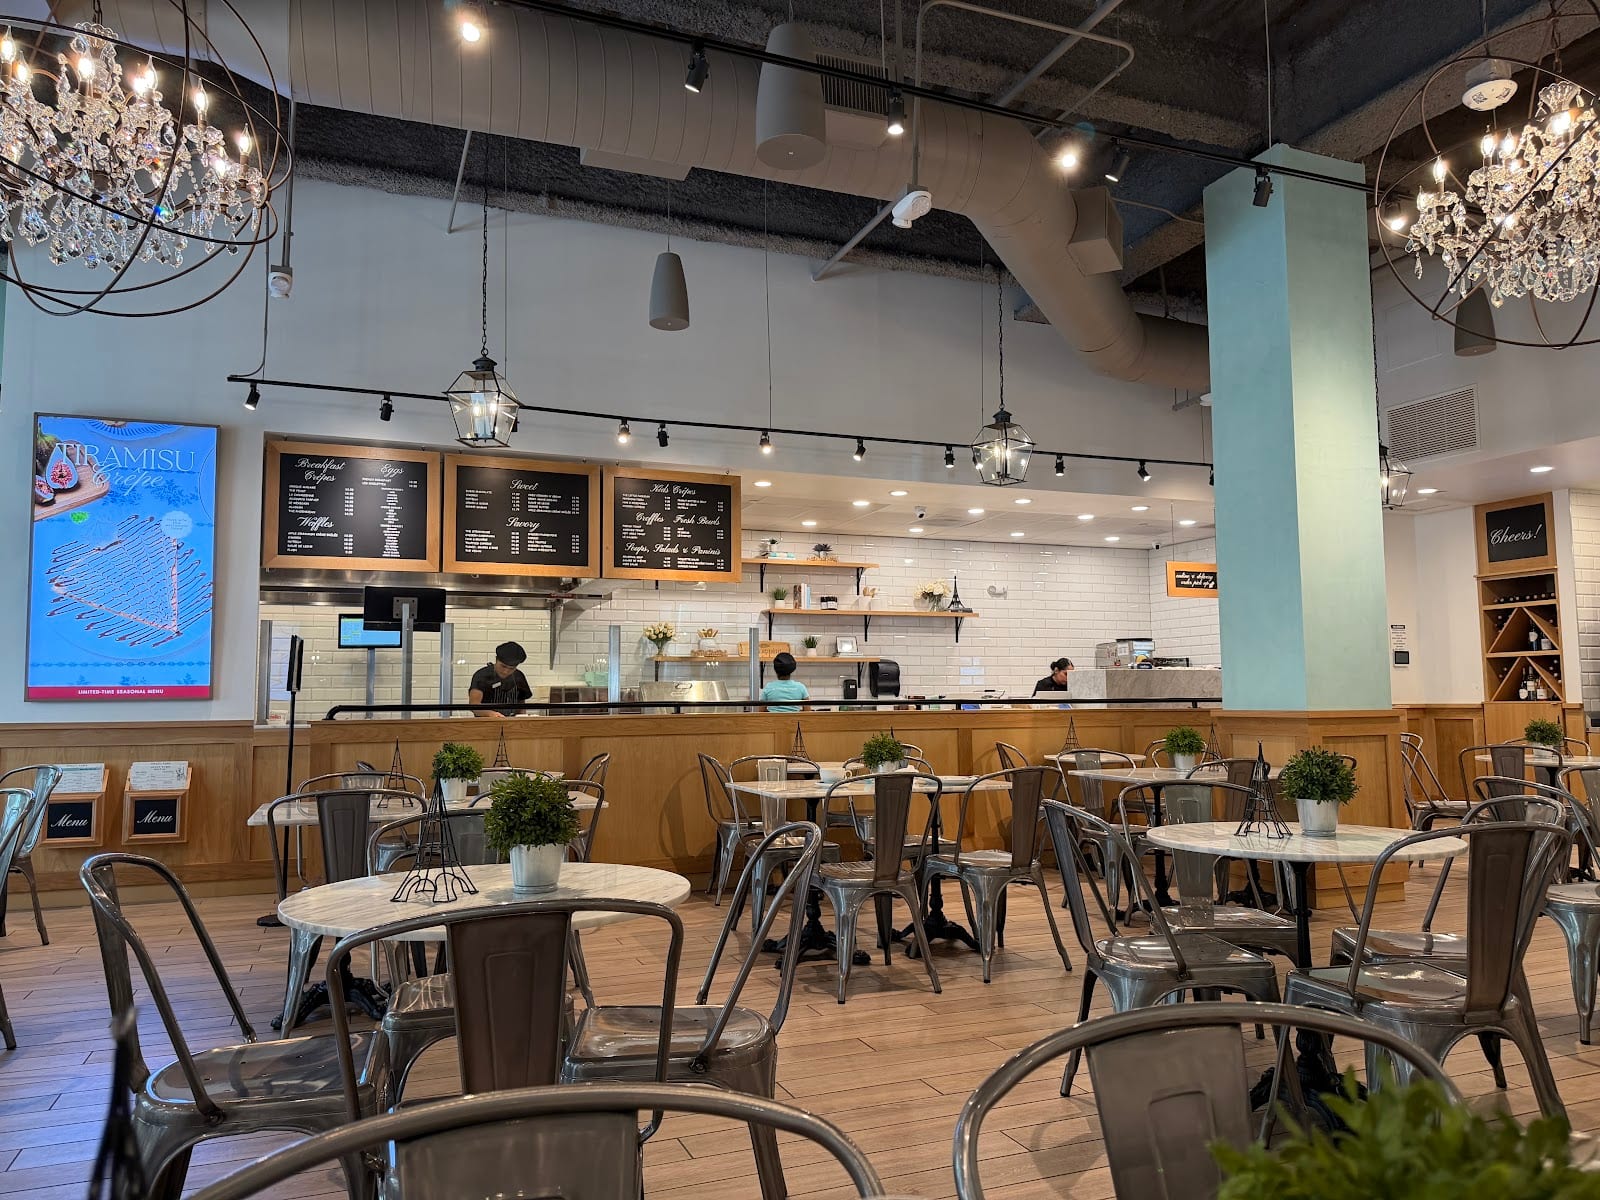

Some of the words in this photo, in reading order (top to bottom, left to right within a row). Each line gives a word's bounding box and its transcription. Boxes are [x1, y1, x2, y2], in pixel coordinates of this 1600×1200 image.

[55, 443, 196, 472] TIRAMISU
[294, 458, 347, 473] Breakfast
[380, 463, 405, 478] Eggs
[92, 462, 165, 496] Crêpe
[304, 470, 337, 485] Crêpes
[509, 479, 539, 490] Sweet
[650, 484, 670, 493] Kids
[672, 485, 696, 497] Crêpes
[297, 517, 335, 531] Waffles
[505, 517, 540, 532] Savory
[673, 514, 696, 524] Fresh
[696, 516, 721, 525] Bowls
[1490, 524, 1543, 546] Cheers!
[653, 543, 680, 553] Salads
[690, 545, 721, 556] Paninis
[50, 814, 89, 828] Menu
[136, 809, 174, 824] Menu
